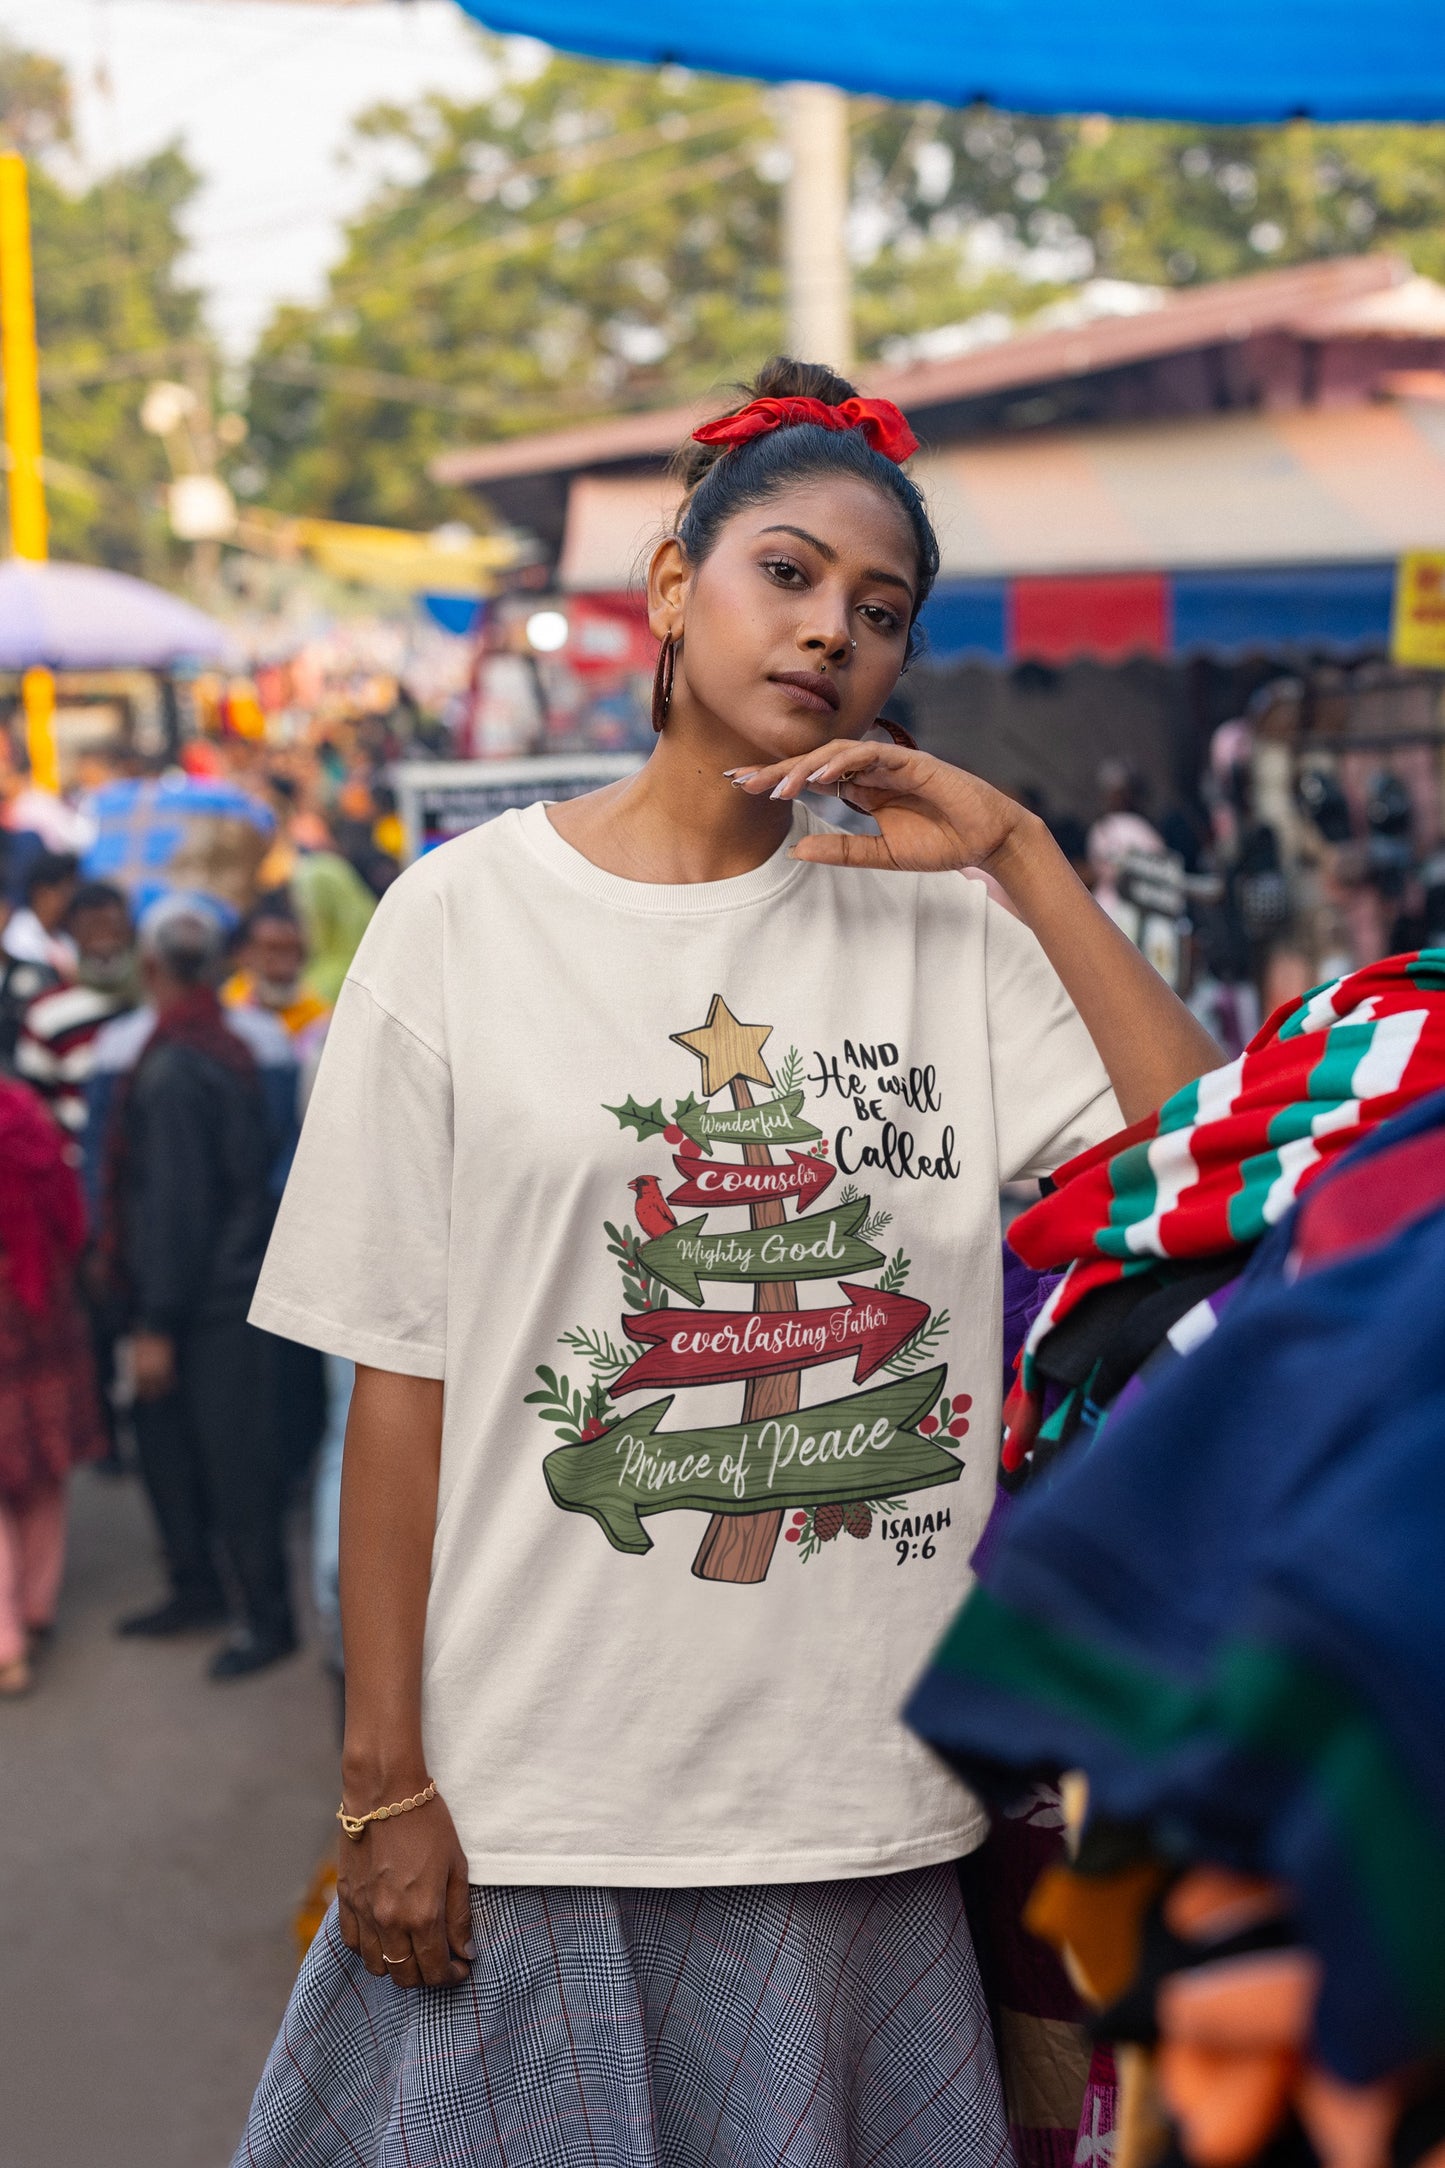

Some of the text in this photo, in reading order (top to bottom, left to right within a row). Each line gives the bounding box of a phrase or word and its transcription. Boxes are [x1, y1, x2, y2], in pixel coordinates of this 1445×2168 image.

[844, 1039, 898, 1070] AND
[807, 1051, 941, 1113] He will
[699, 1105, 794, 1138] Wonderful
[853, 1097, 887, 1121] BE
[835, 1122, 960, 1180] Called
[677, 1220, 846, 1272] Mighty God
[671, 1304, 888, 1354] everlasting Father
[615, 1417, 899, 1498] Prince of Peace
[881, 1507, 951, 1540] ISAIAH
[895, 1535, 936, 1566] 9:6
